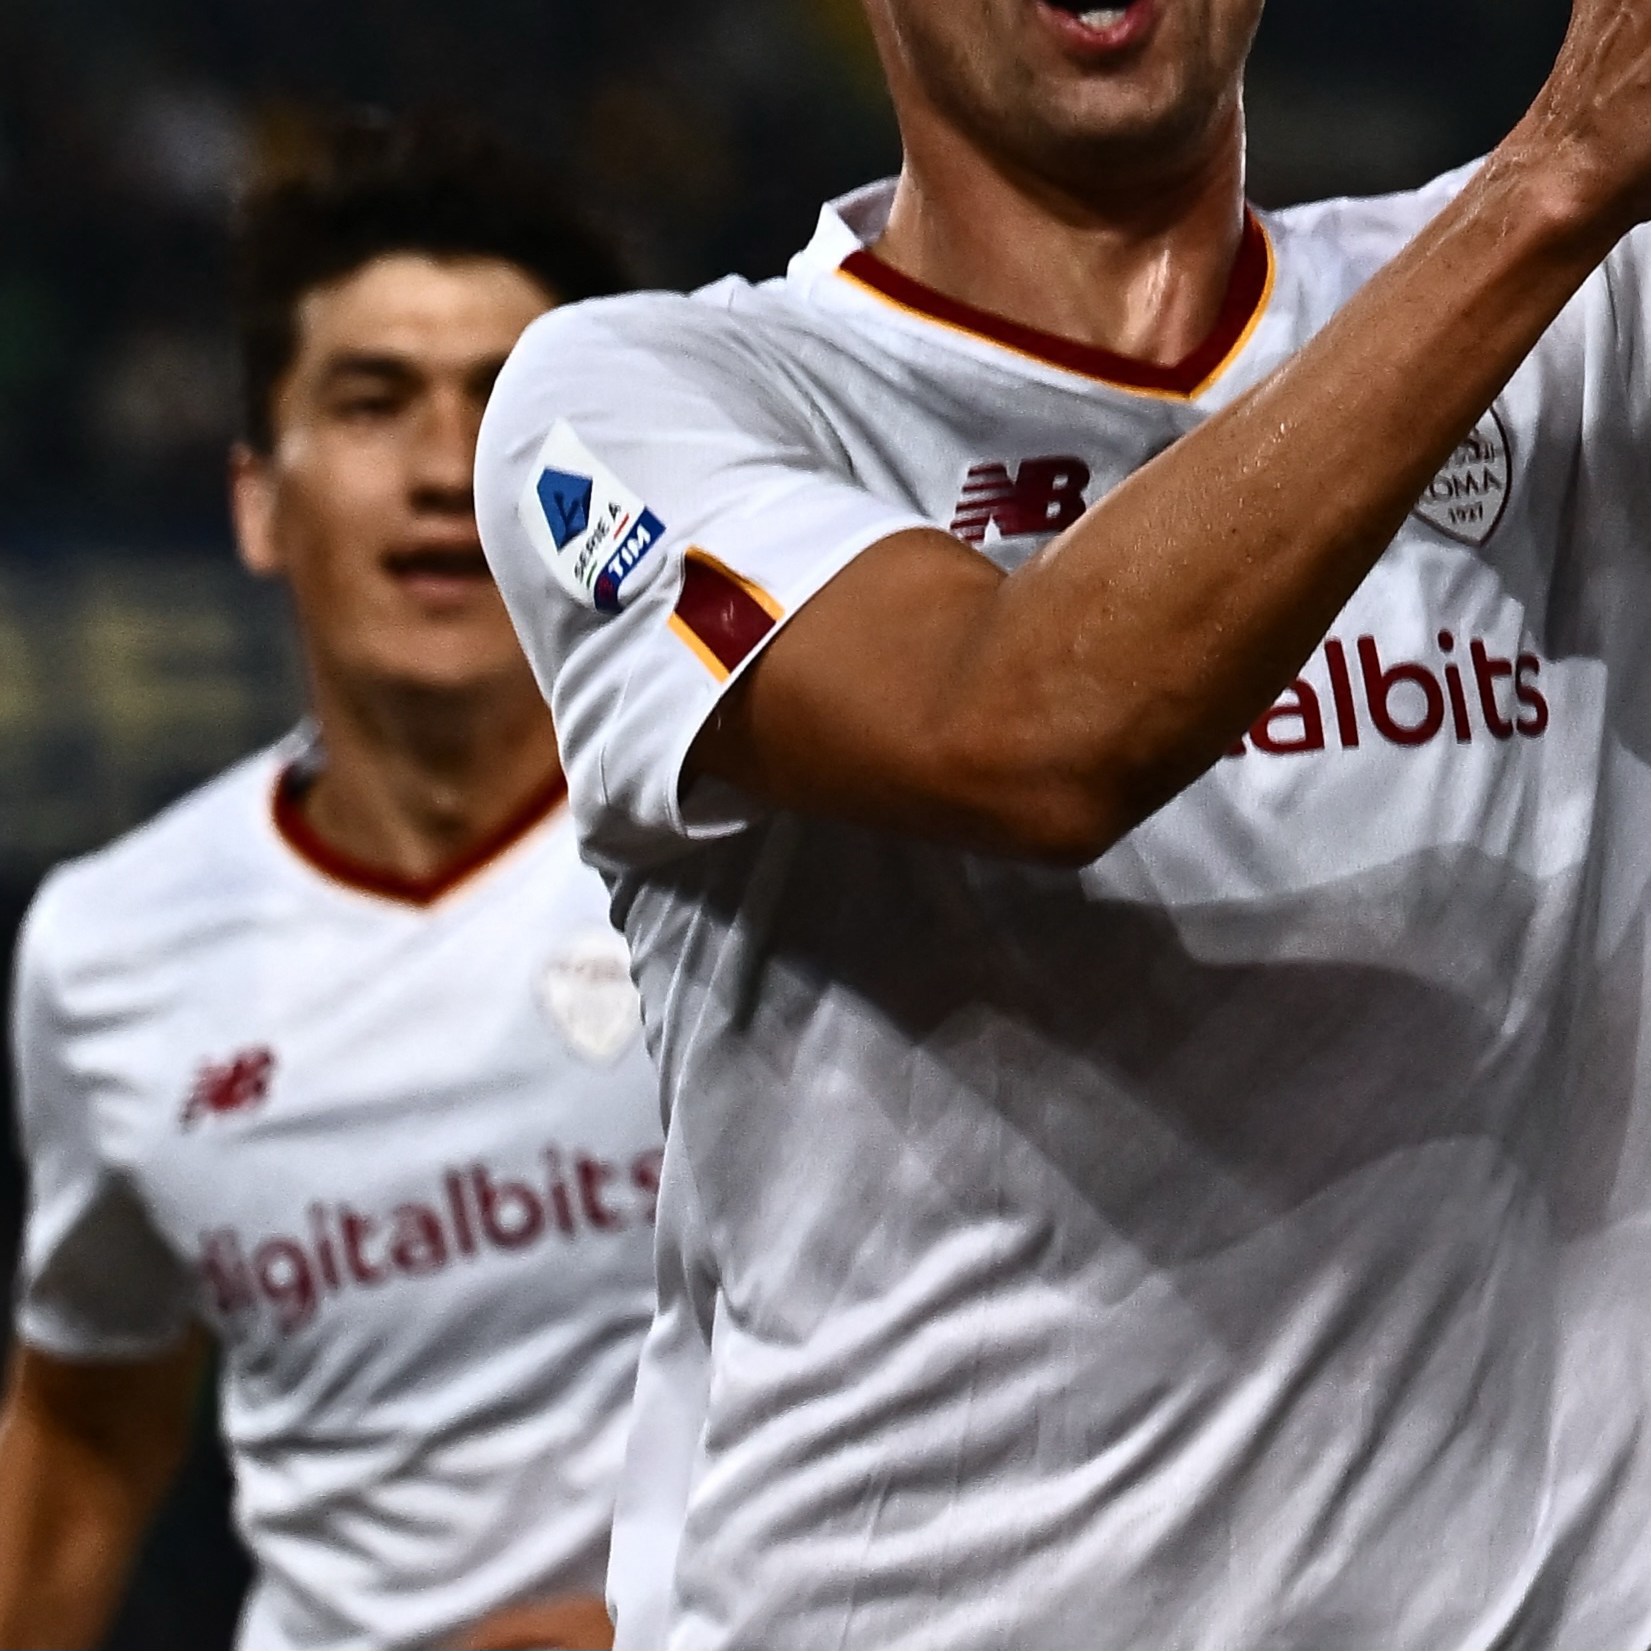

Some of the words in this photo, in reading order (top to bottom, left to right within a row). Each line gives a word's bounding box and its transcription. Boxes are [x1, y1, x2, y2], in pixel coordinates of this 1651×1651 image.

[1421, 467, 1502, 504] OMA
[608, 522, 652, 580] TIM
[1222, 628, 1550, 758] albits
